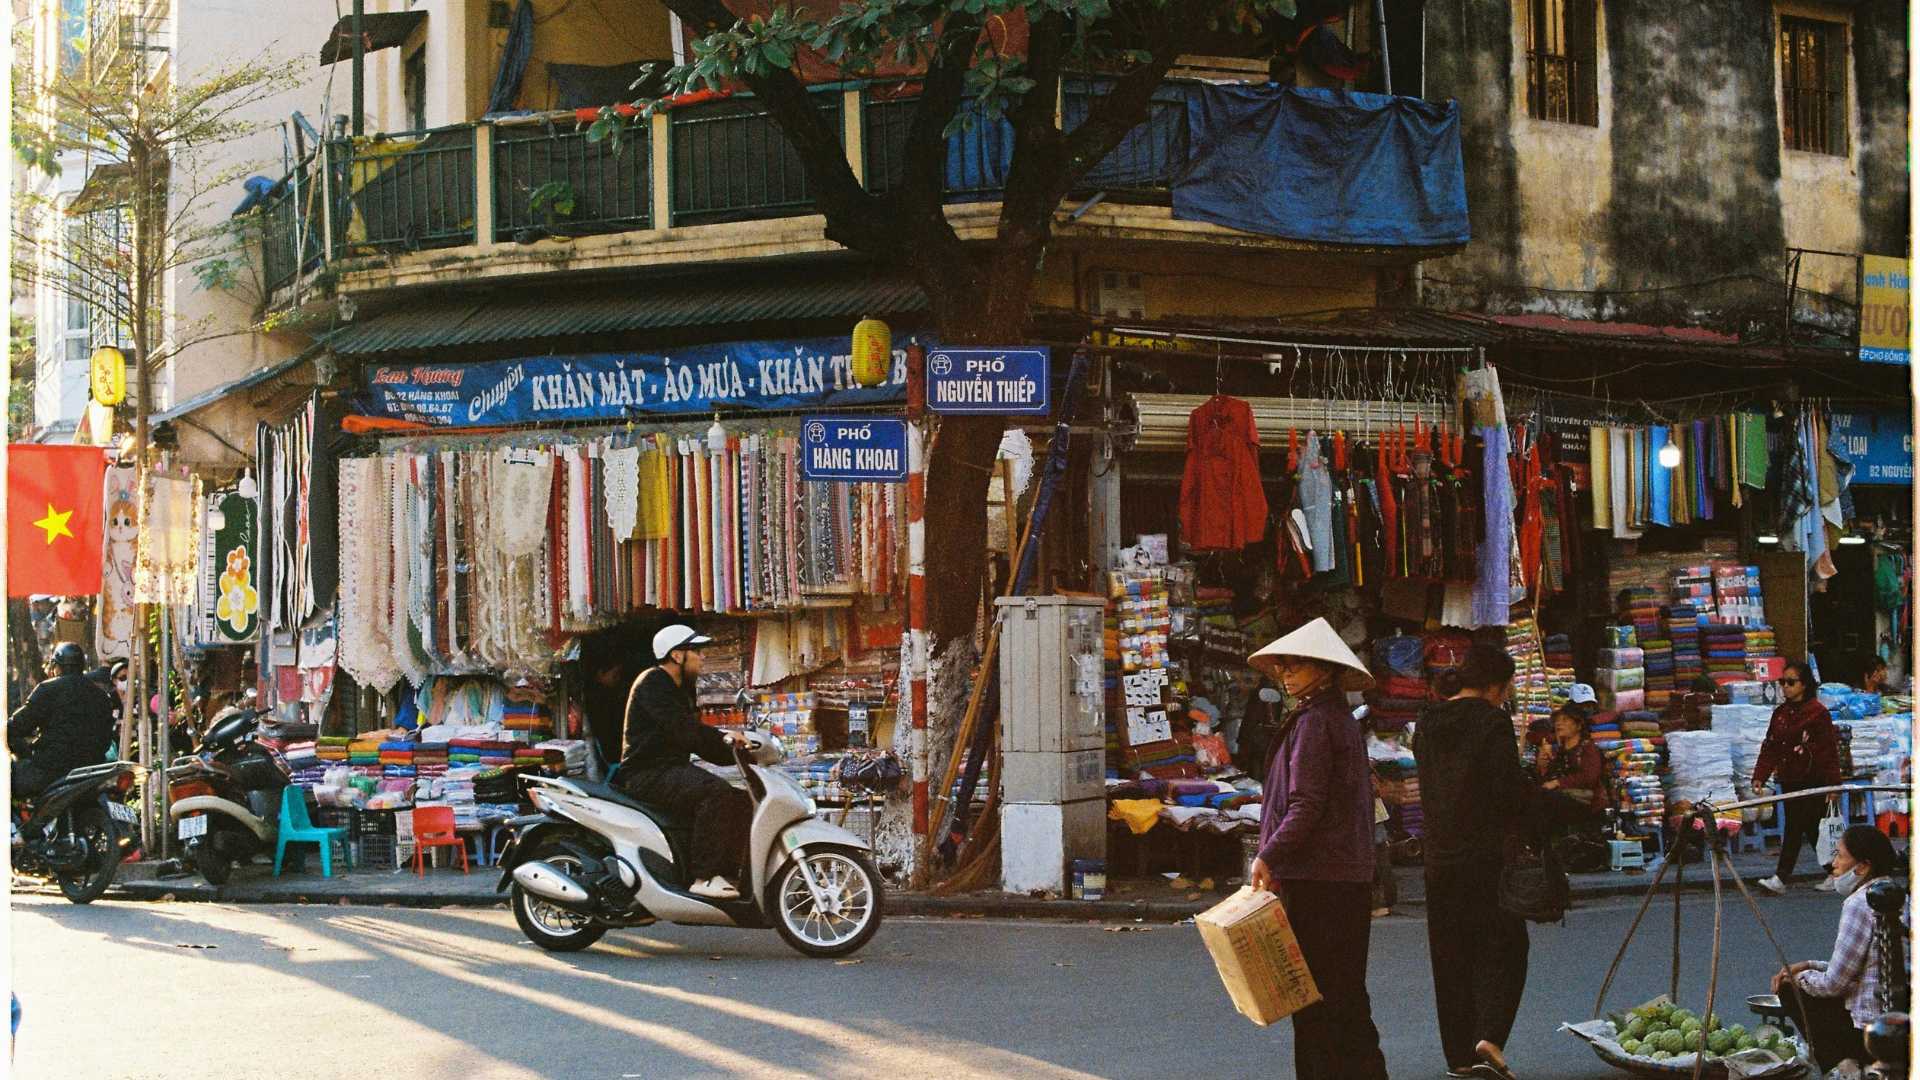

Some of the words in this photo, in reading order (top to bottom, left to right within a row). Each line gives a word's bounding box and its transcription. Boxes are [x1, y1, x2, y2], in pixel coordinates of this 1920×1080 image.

[966, 355, 1006, 373] PHỐ
[468, 363, 525, 421] Chuyên
[532, 361, 594, 411] KHĂN
[663, 356, 694, 402] ÁO
[697, 354, 746, 399] MƯA
[758, 346, 825, 396] KHĂN
[937, 373, 993, 403] NGUYỄN
[996, 374, 1036, 403] THIẾP
[837, 423, 872, 440] PHỐ
[813, 442, 852, 470] HÀNG
[855, 448, 899, 471] KHOAI
[1848, 435, 1868, 460] LOẠI
